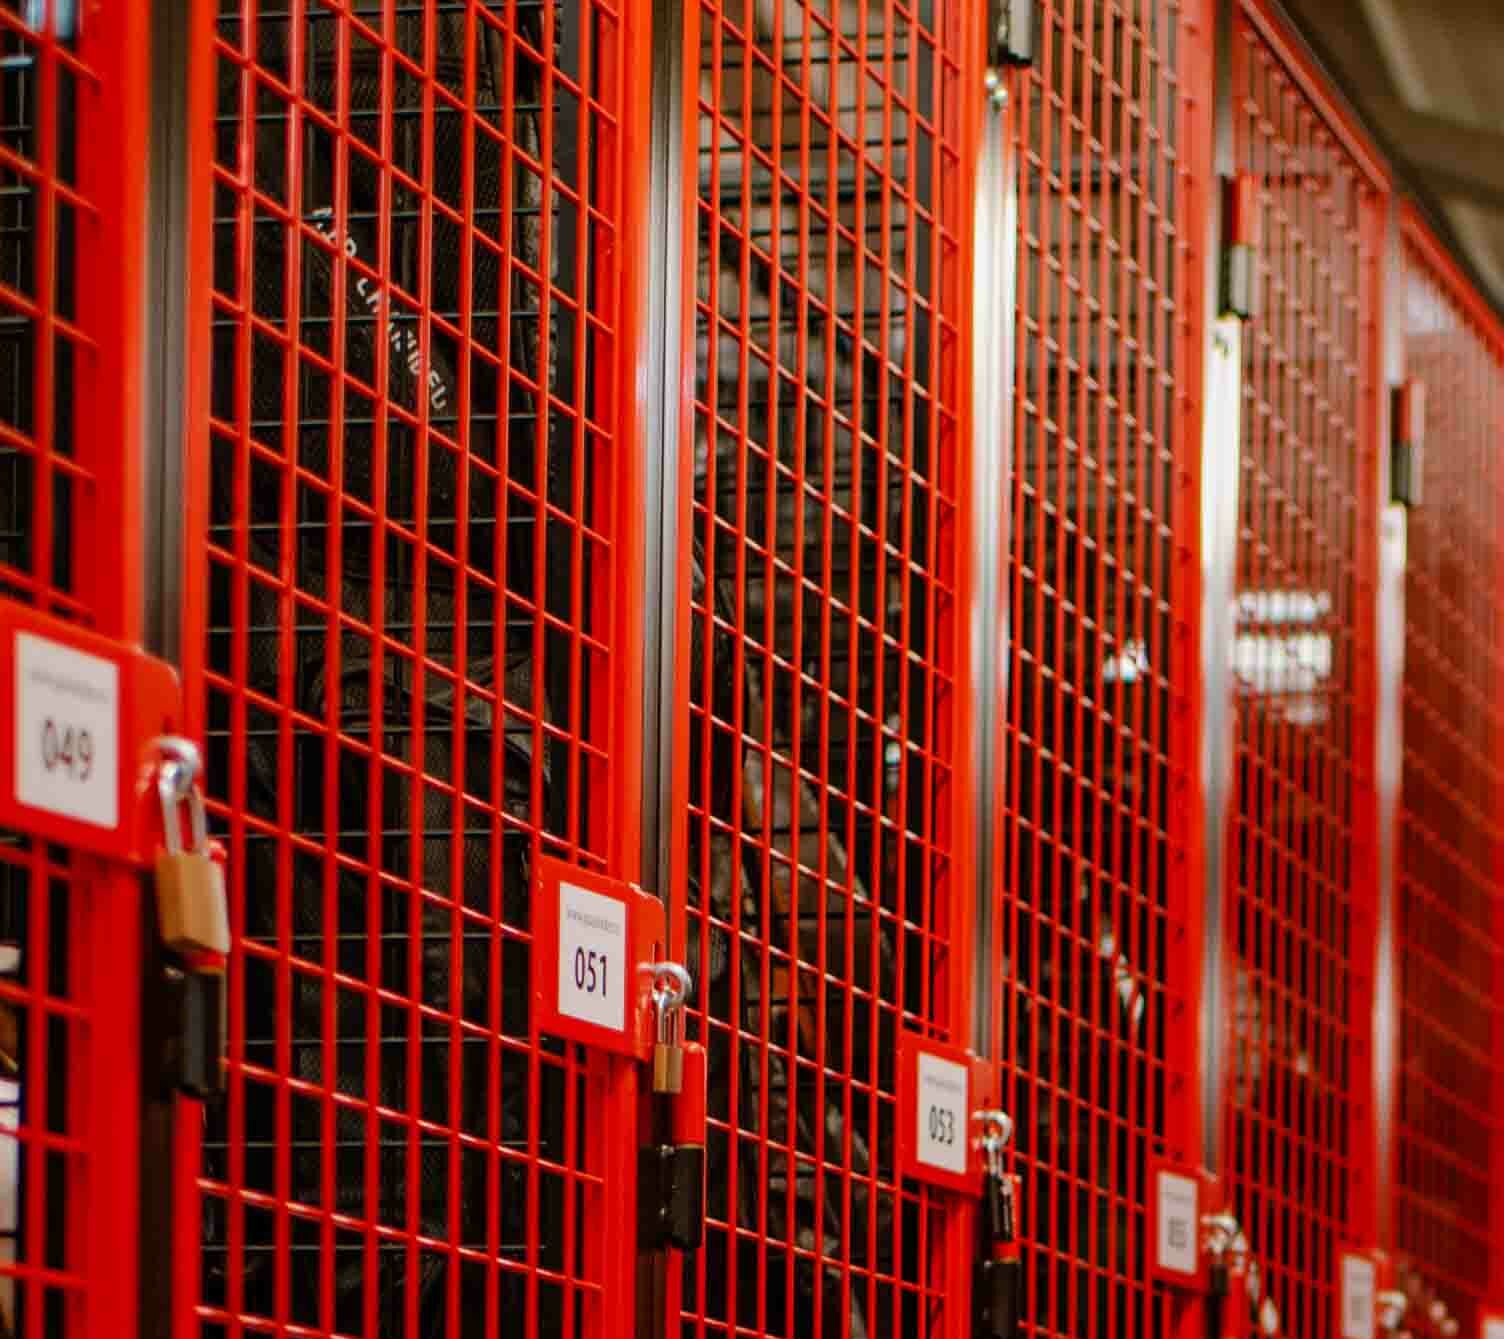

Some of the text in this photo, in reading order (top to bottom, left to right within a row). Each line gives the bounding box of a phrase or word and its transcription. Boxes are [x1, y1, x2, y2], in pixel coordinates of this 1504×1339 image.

[41, 717, 95, 782] 049
[573, 945, 609, 1000] 051
[928, 1104, 955, 1146] 053
